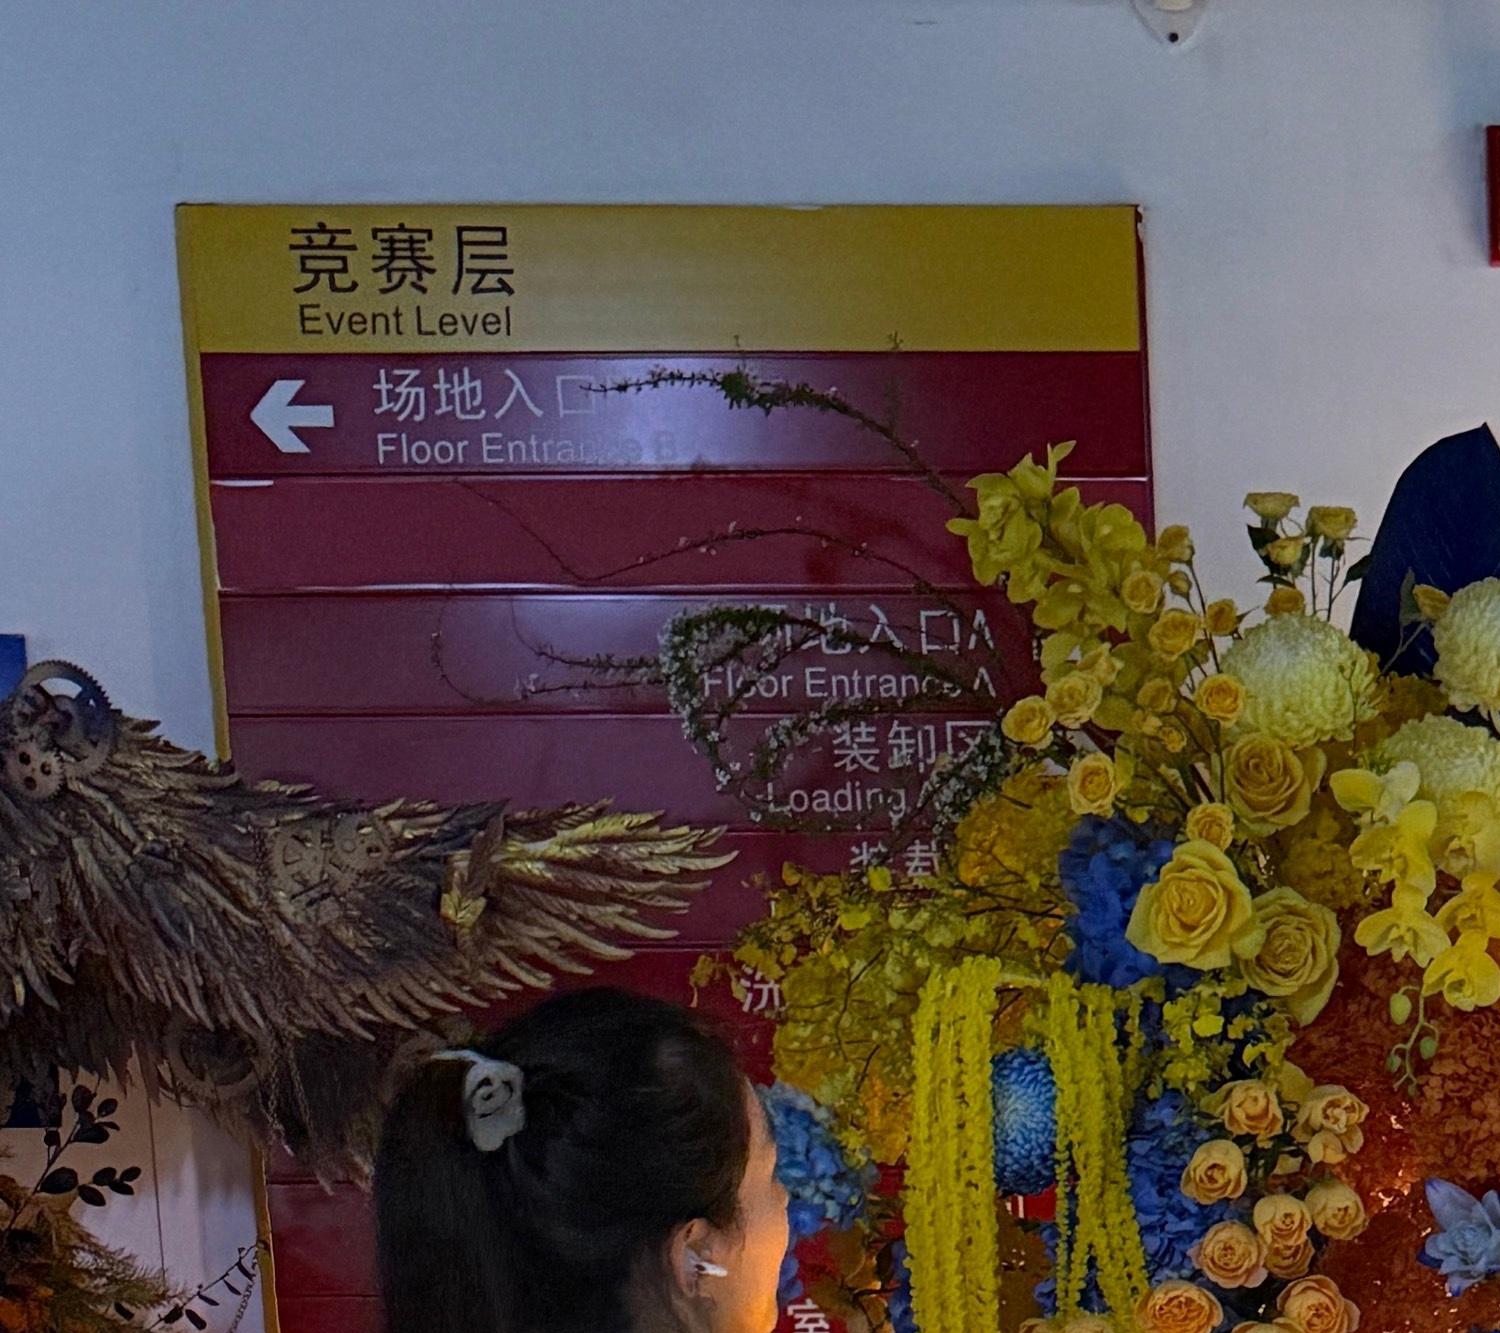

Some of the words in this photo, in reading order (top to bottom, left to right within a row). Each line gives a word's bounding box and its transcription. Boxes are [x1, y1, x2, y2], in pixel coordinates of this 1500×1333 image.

[289, 221, 515, 296] 竞赛层
[300, 303, 403, 336] Event
[416, 304, 512, 336] Level
[372, 367, 595, 422] 场地入口
[377, 433, 469, 464] Floor
